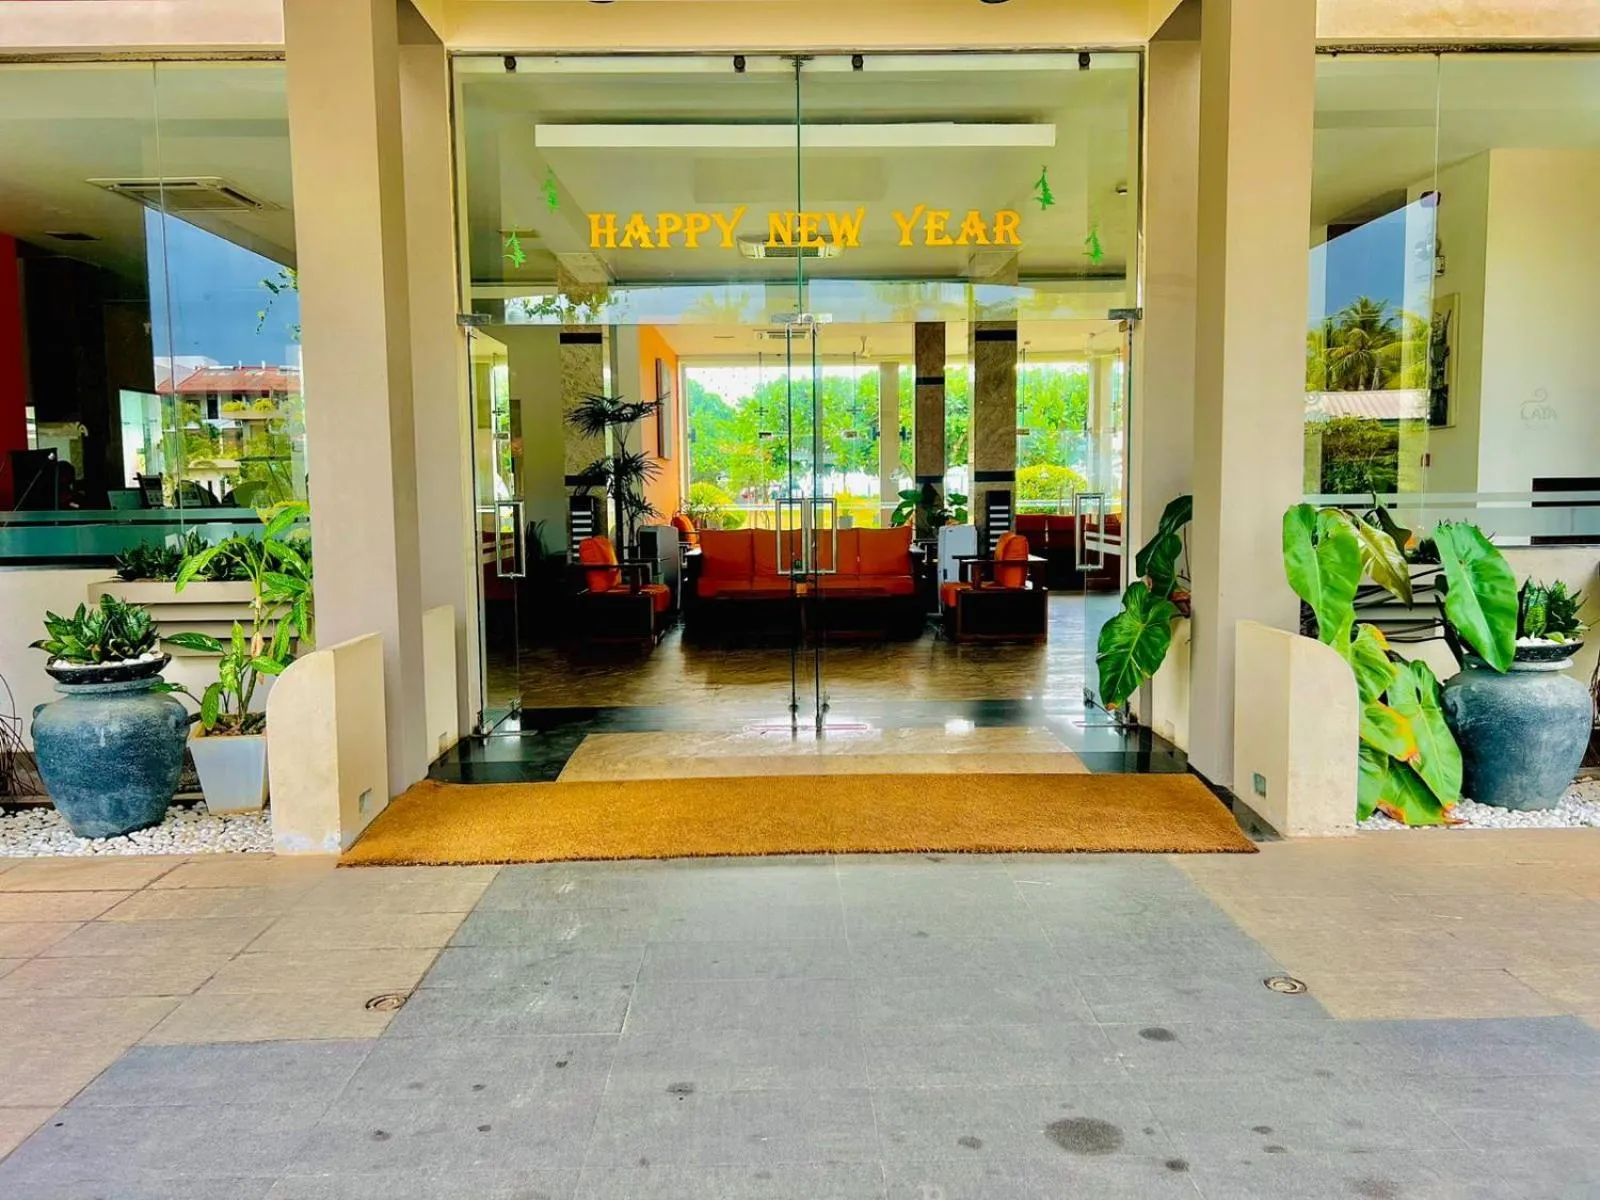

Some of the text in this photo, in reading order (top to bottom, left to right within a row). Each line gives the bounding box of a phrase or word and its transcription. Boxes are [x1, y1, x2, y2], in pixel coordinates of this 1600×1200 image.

[587, 204, 1023, 250] HAPPY NEW YEAR
